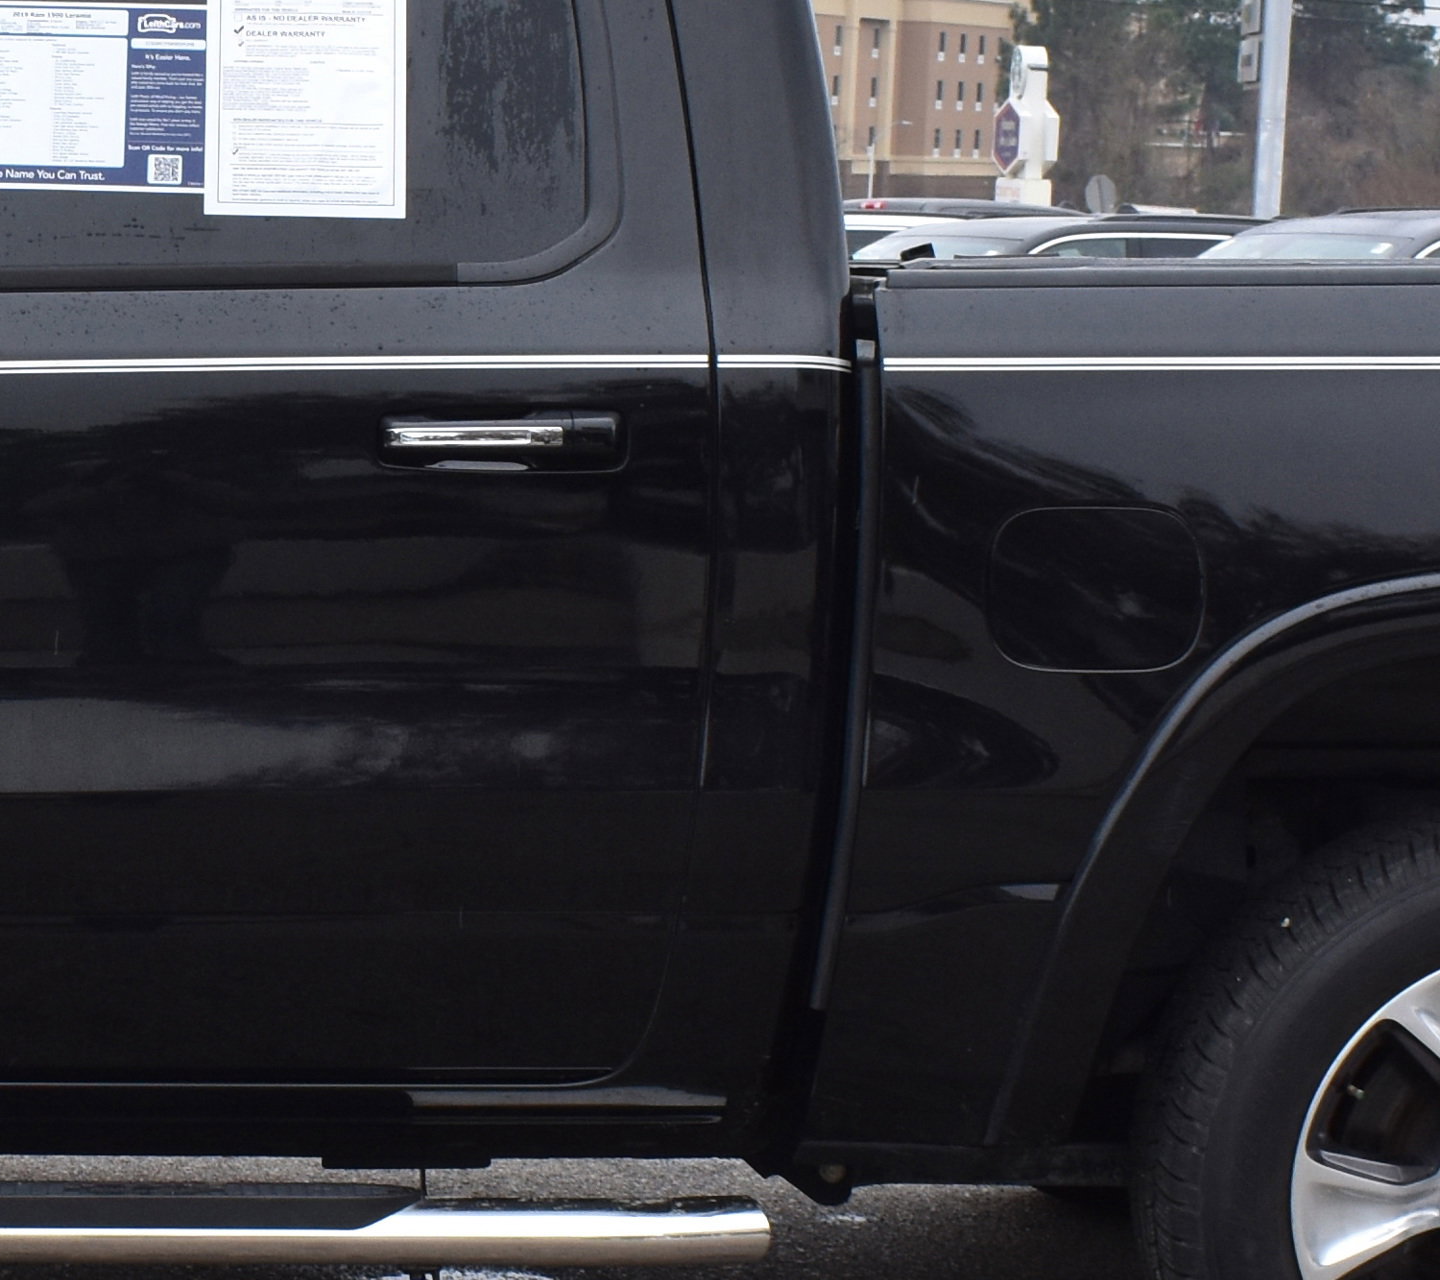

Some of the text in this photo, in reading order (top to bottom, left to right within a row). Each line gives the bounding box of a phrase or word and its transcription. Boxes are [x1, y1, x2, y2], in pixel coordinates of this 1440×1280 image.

[5, 169, 35, 179] Name
[36, 169, 55, 179] You
[57, 170, 76, 180] Can
[79, 170, 105, 181] Trust.
